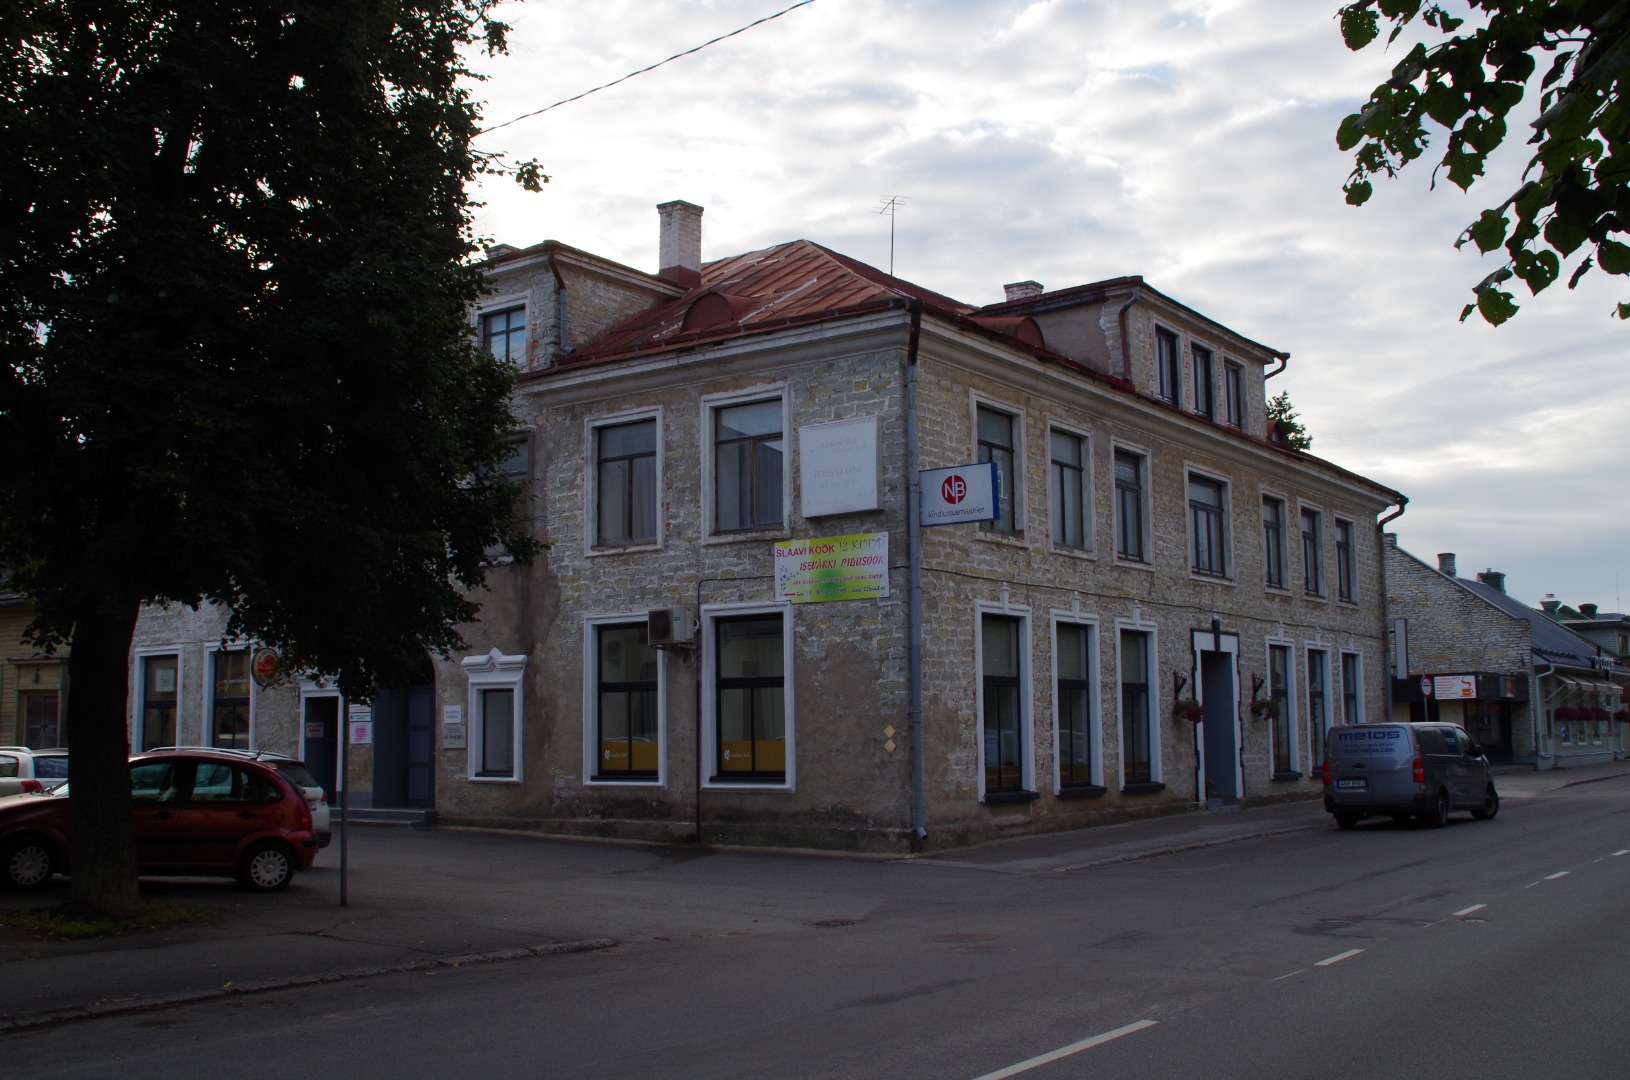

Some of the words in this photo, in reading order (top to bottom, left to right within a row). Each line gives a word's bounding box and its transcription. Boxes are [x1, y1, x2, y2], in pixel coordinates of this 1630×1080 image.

[943, 475, 966, 505] NB
[928, 507, 985, 519] kindlustusmaakler
[776, 547, 807, 558] SLAAVI
[809, 544, 835, 555] KÖÖK
[838, 541, 848, 552] 12
[799, 559, 837, 572] ISEVÄRKI
[840, 554, 884, 567] PIDUSÖÖK
[1338, 730, 1400, 742] metos
